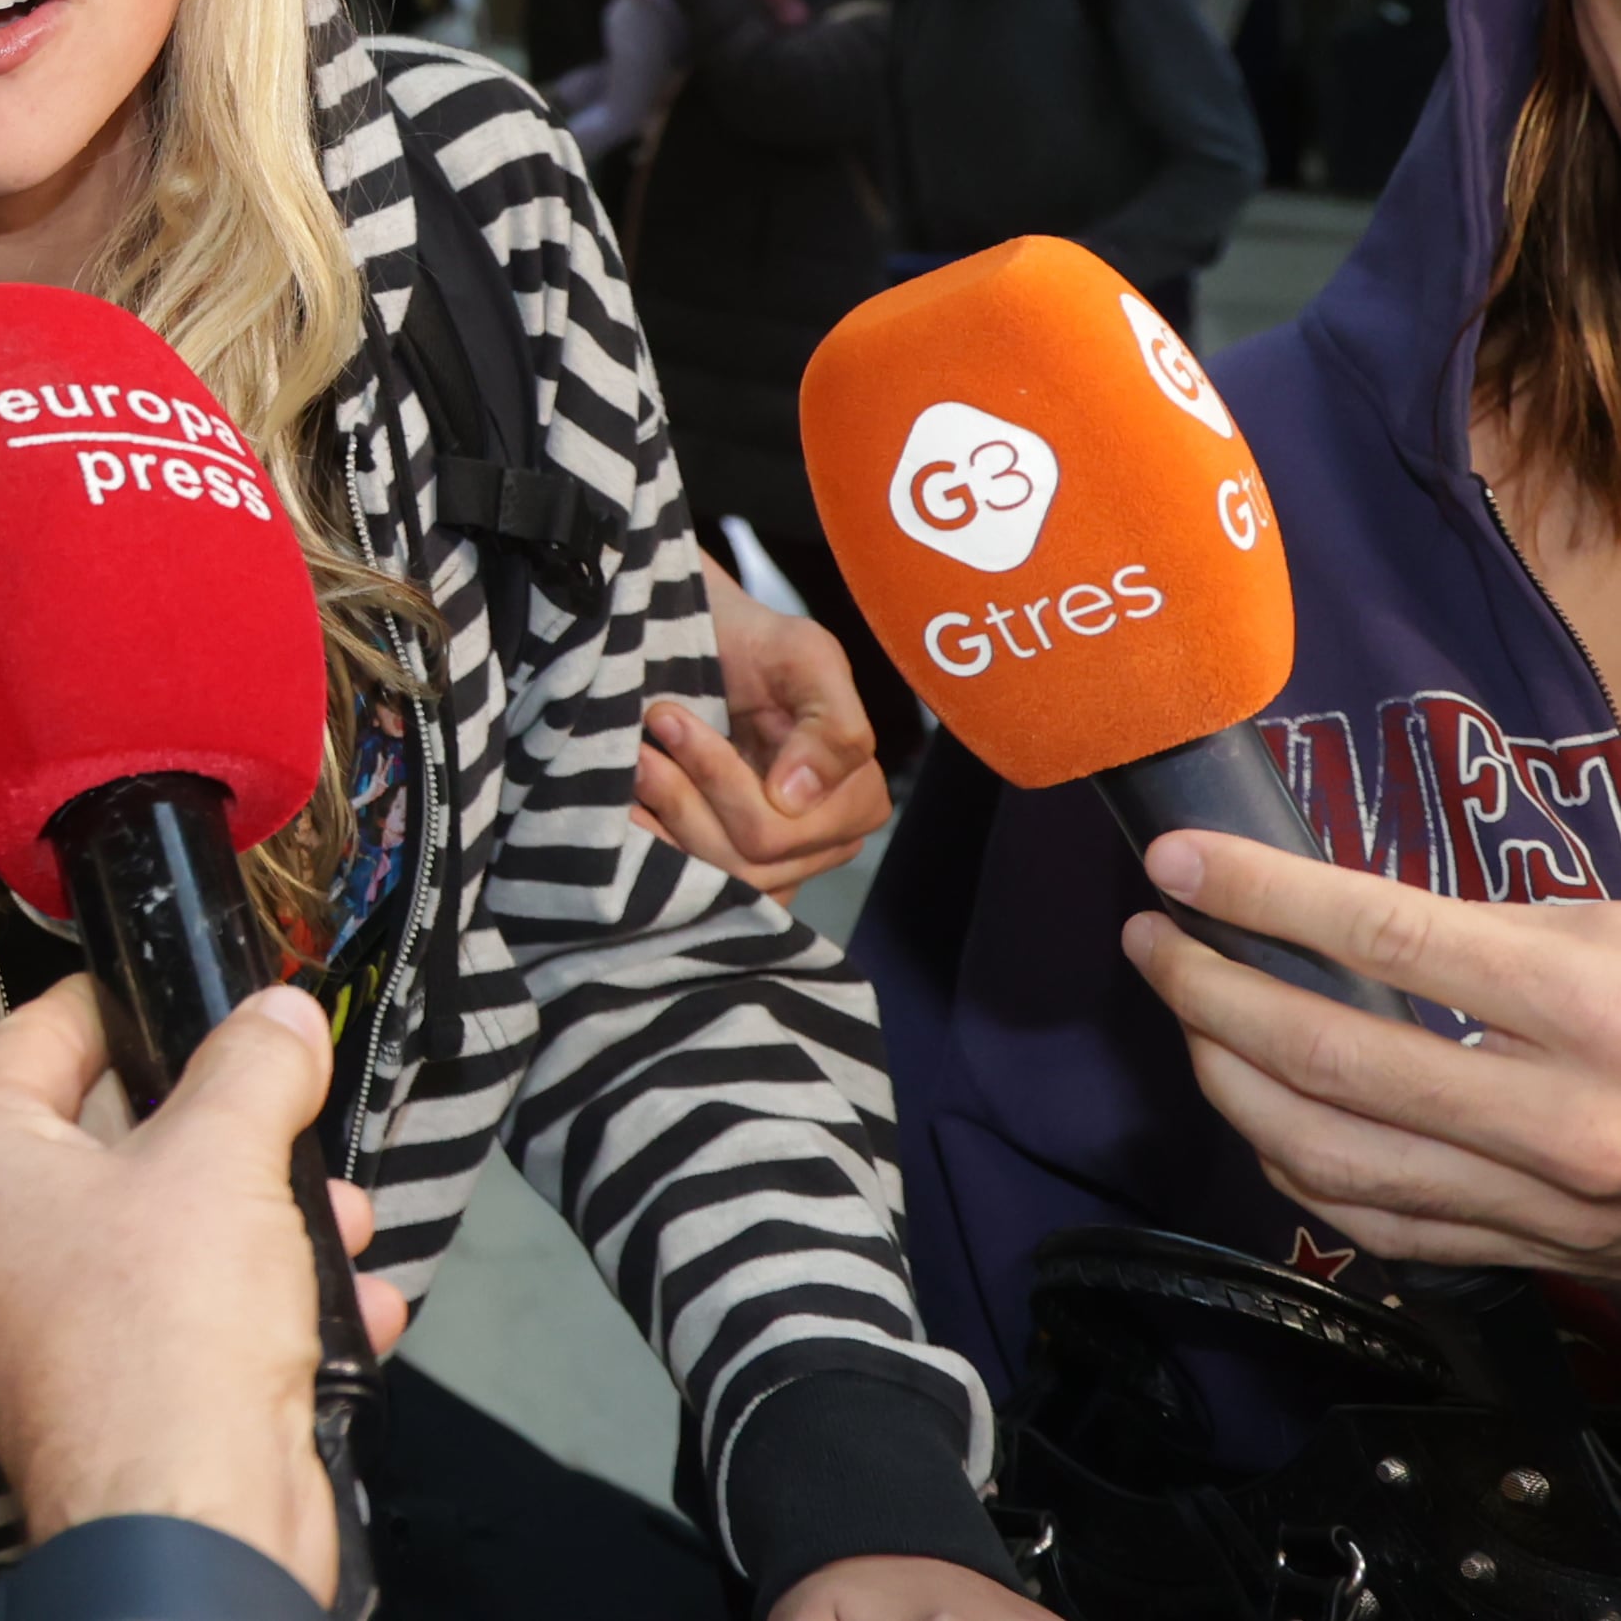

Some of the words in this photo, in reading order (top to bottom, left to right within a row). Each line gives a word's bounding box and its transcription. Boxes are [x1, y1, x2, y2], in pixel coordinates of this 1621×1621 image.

[76, 450, 272, 521] press
[910, 440, 1034, 532] G3
[923, 564, 1163, 678] Gtres
